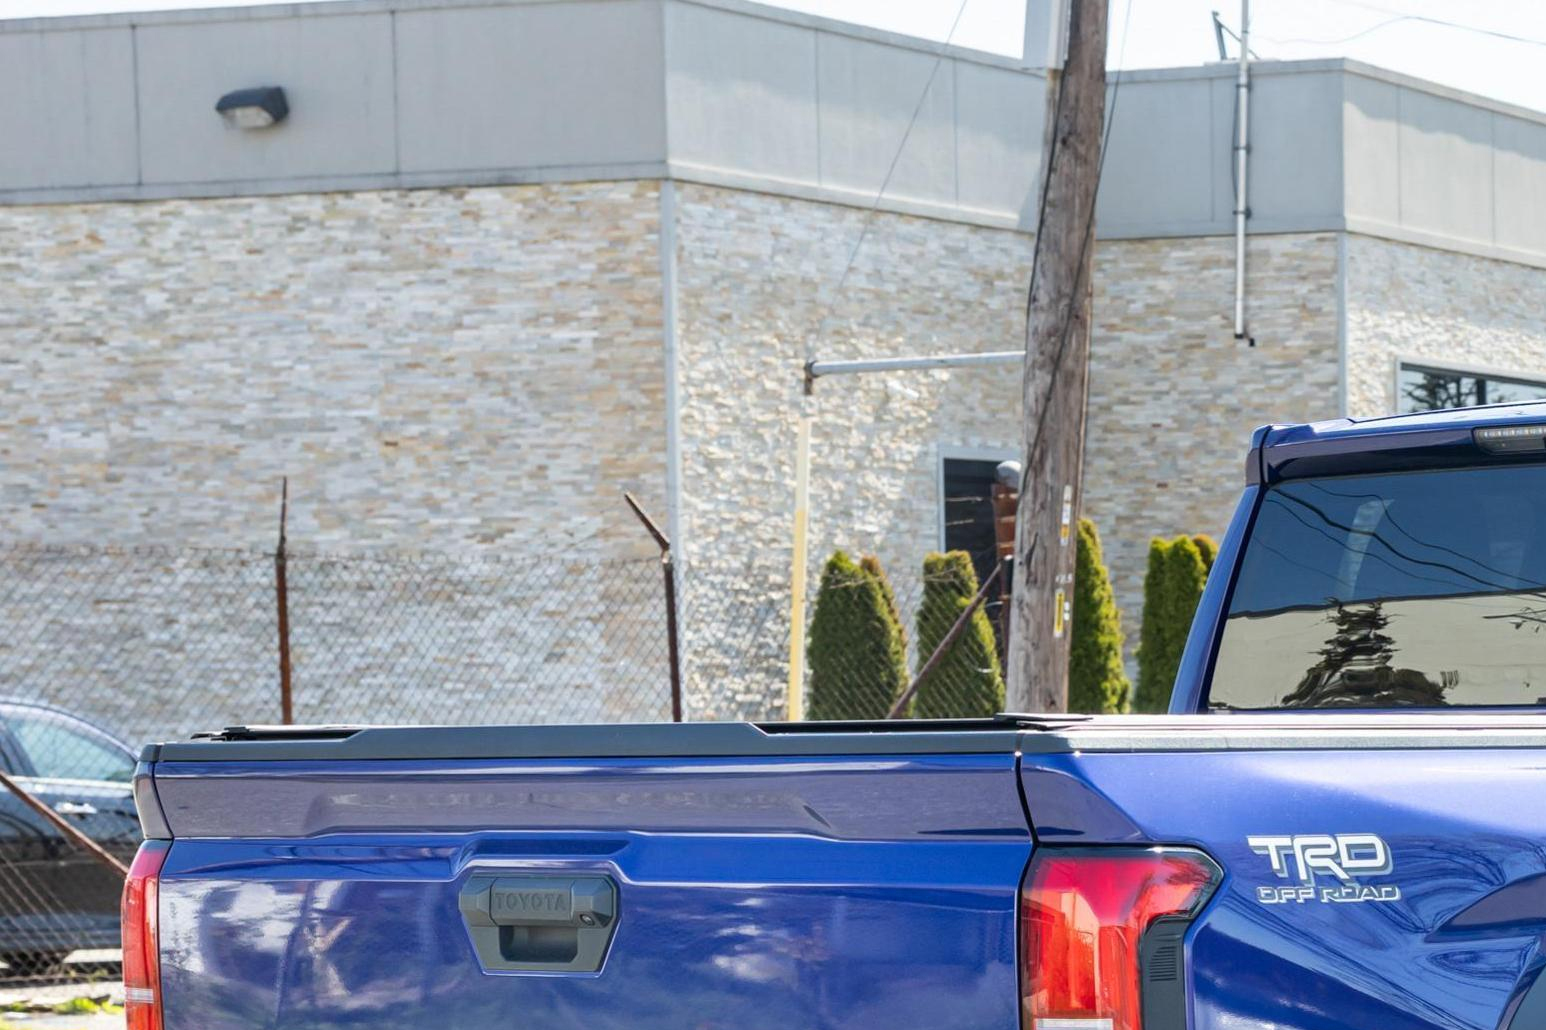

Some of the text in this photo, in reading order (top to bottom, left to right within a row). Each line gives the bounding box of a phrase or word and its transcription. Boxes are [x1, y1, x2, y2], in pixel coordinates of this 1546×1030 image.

[1247, 832, 1394, 888] TRD
[494, 892, 568, 912] TOYOTA
[1256, 884, 1401, 904] OFF ROAD
